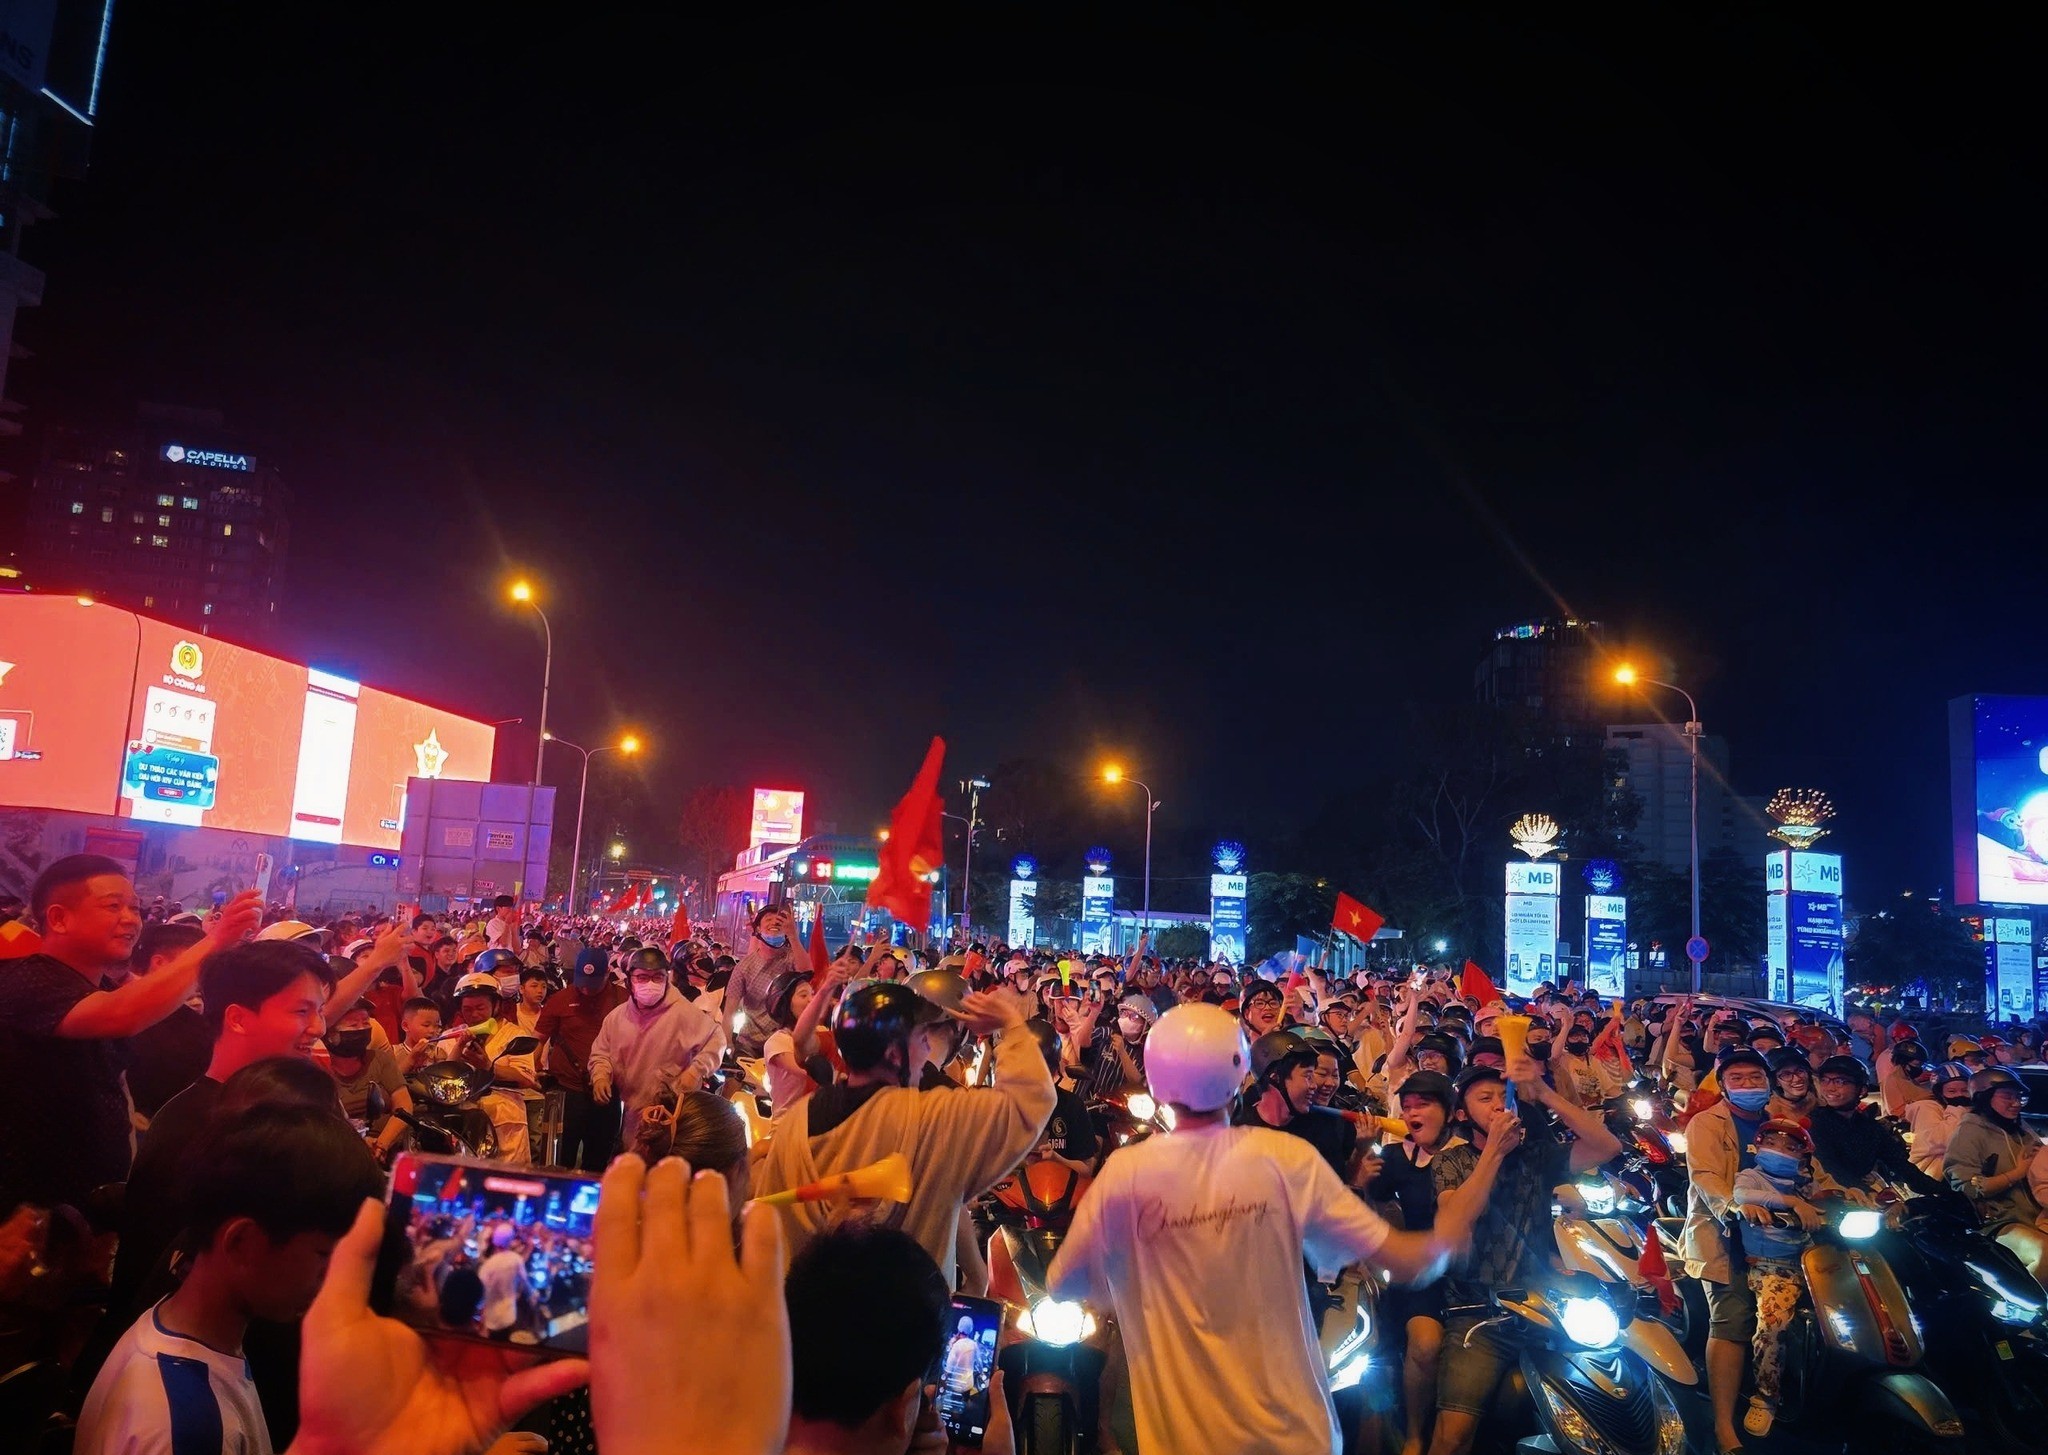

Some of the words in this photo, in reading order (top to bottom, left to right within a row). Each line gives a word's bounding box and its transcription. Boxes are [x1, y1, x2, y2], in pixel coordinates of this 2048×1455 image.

[187, 450, 247, 466] CAPELLA
[186, 459, 247, 471] HOLDINGS
[1768, 864, 1783, 879] MB
[1820, 865, 1840, 883] MB
[1528, 871, 1553, 885] MB
[1097, 883, 1111, 892] MB
[1228, 881, 1244, 892] MB
[1607, 902, 1624, 913] MB
[2015, 926, 2030, 937] MB
